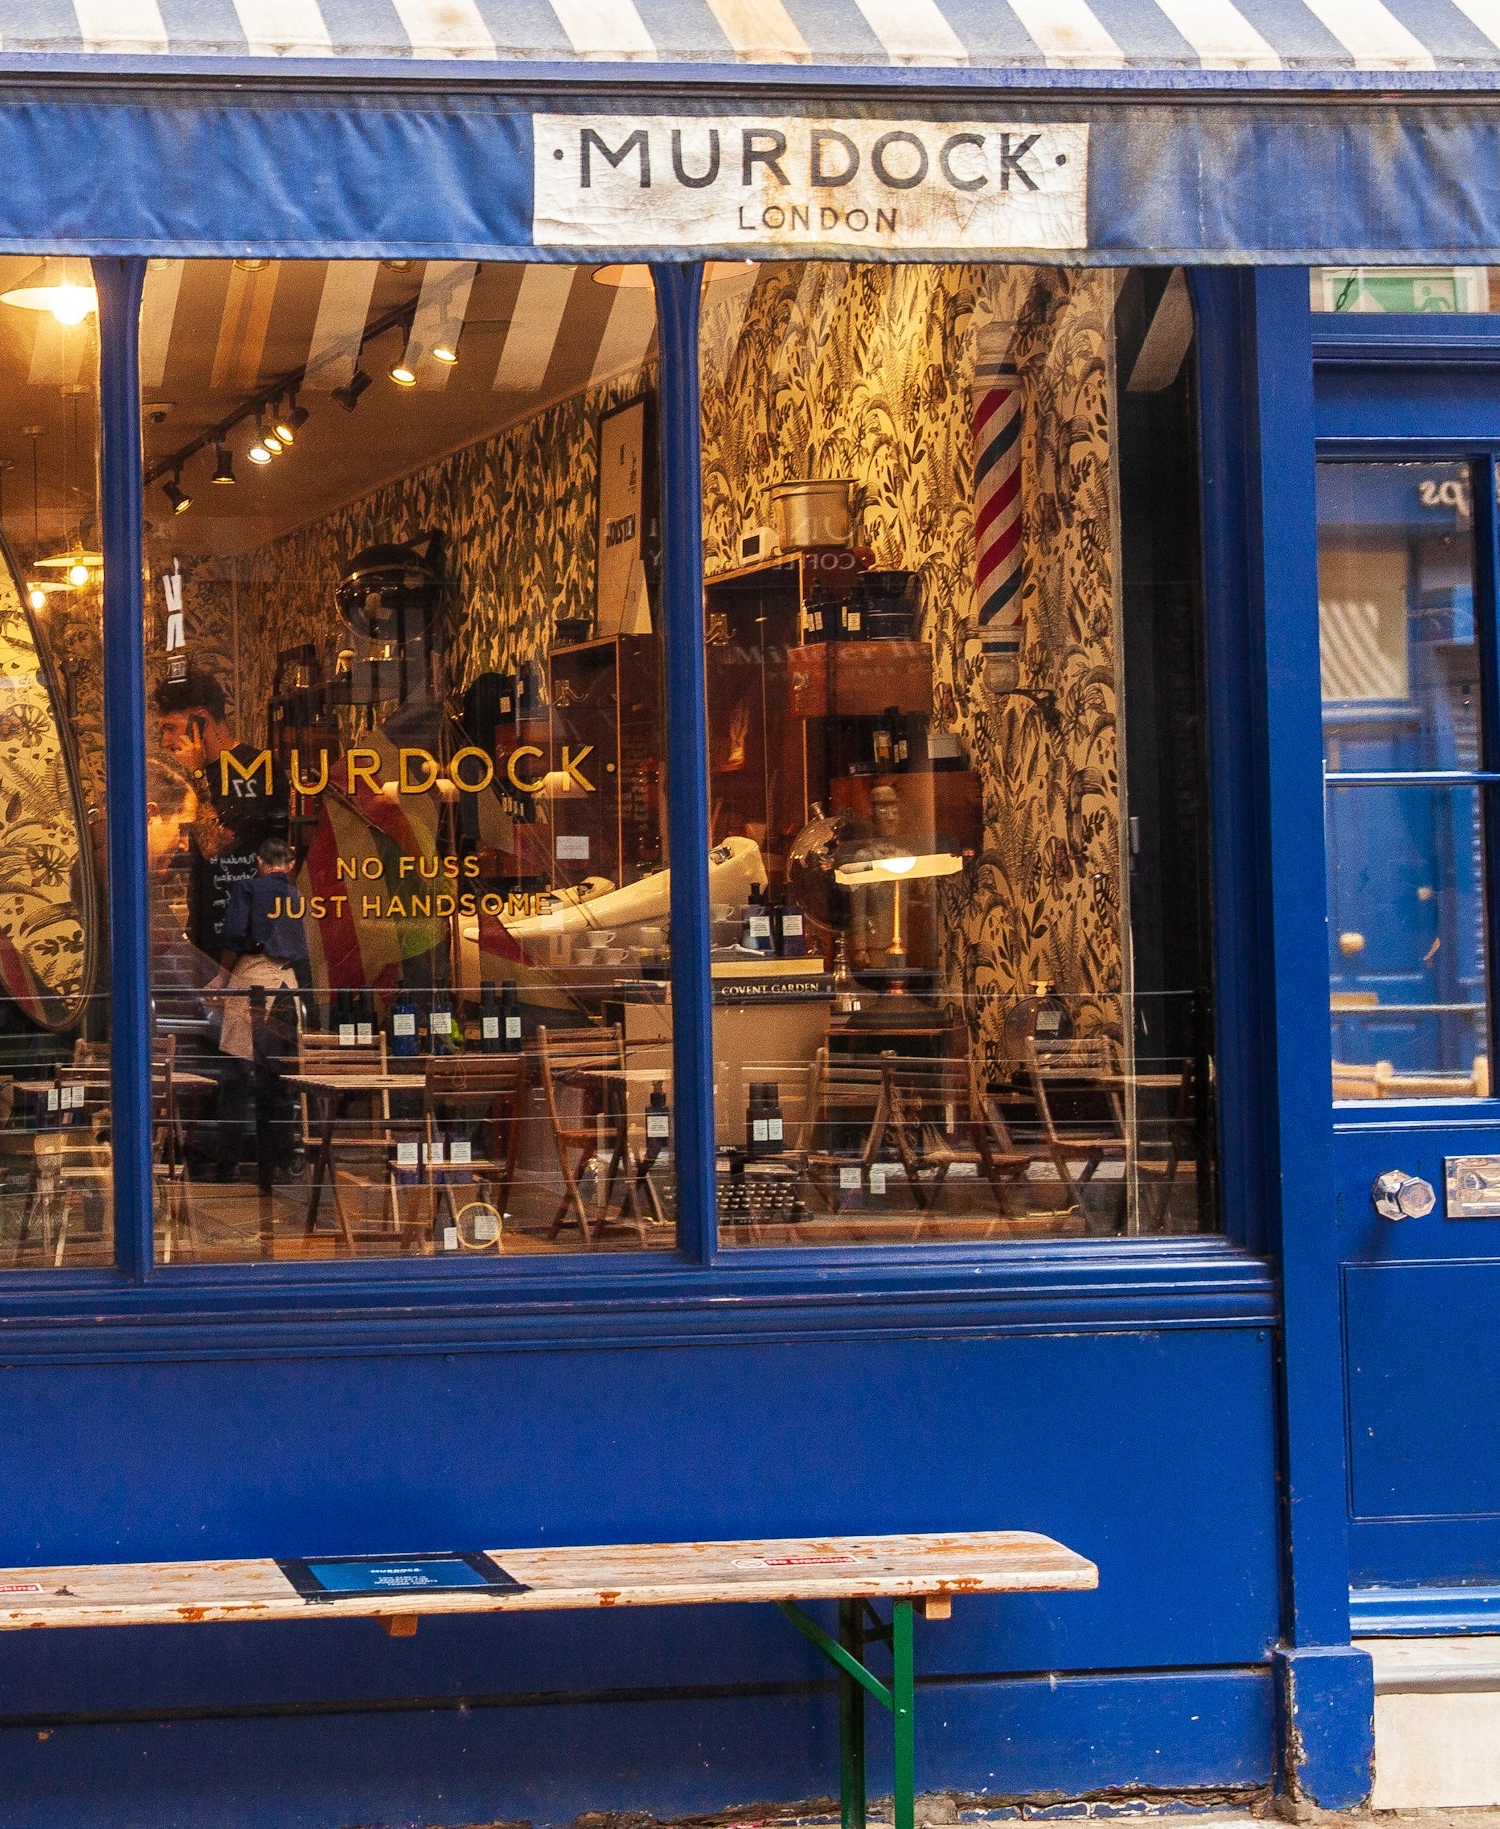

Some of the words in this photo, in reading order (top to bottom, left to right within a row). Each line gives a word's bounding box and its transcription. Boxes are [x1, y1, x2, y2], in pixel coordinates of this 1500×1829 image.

[579, 128, 1041, 192] MURDOCK
[737, 204, 899, 233] LONDON
[220, 745, 598, 797] MURDOCK
[336, 856, 383, 880] NO
[400, 855, 480, 879] FUSS
[266, 895, 346, 919] JUST
[362, 892, 552, 918] HANDSOME
[721, 985, 768, 996] COVENT
[771, 982, 819, 994] GARDEN
